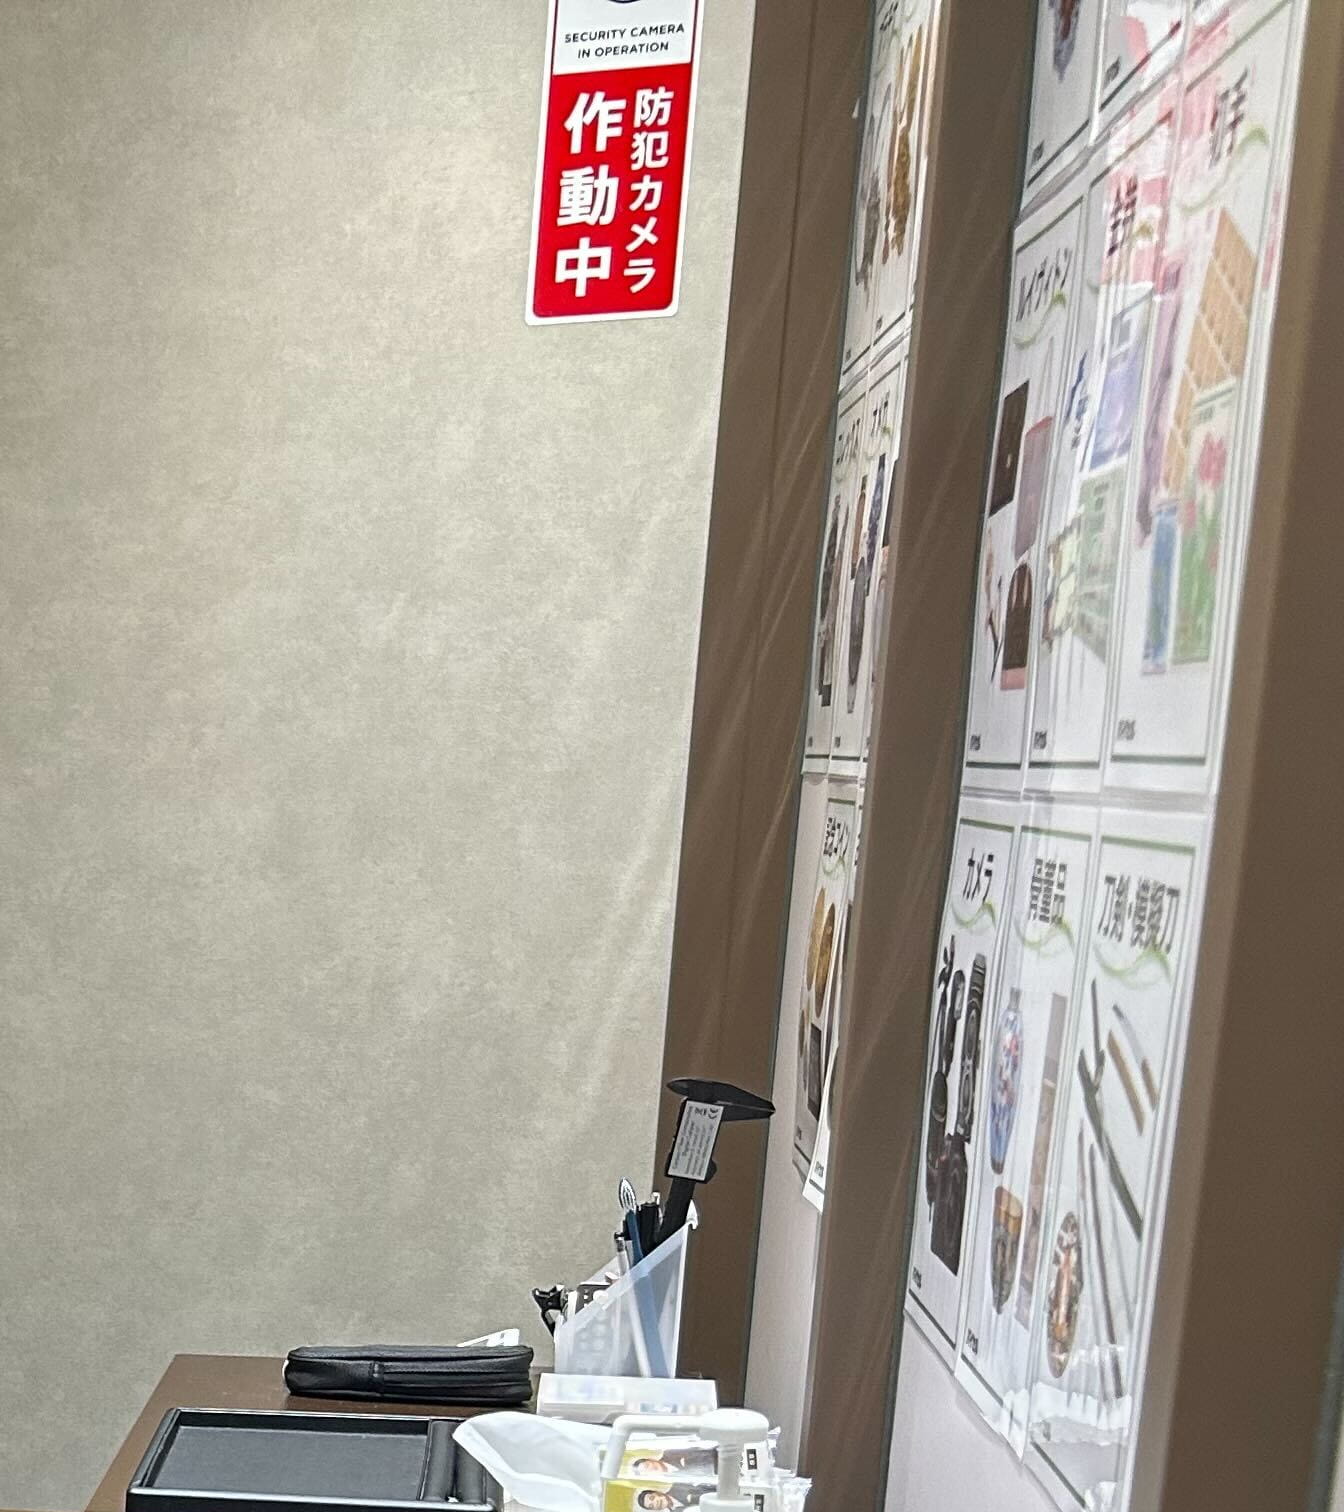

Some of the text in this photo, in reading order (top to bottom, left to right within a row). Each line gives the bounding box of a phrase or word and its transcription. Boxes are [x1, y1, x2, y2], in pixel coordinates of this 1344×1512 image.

[564, 23, 685, 44] SECURITY CAMERA
[577, 42, 669, 59] IN OPERATION
[555, 90, 627, 298] 作動中
[623, 86, 675, 294] 防犯カメラ
[962, 847, 995, 902] カメラ
[1028, 857, 1068, 925] 骨董品
